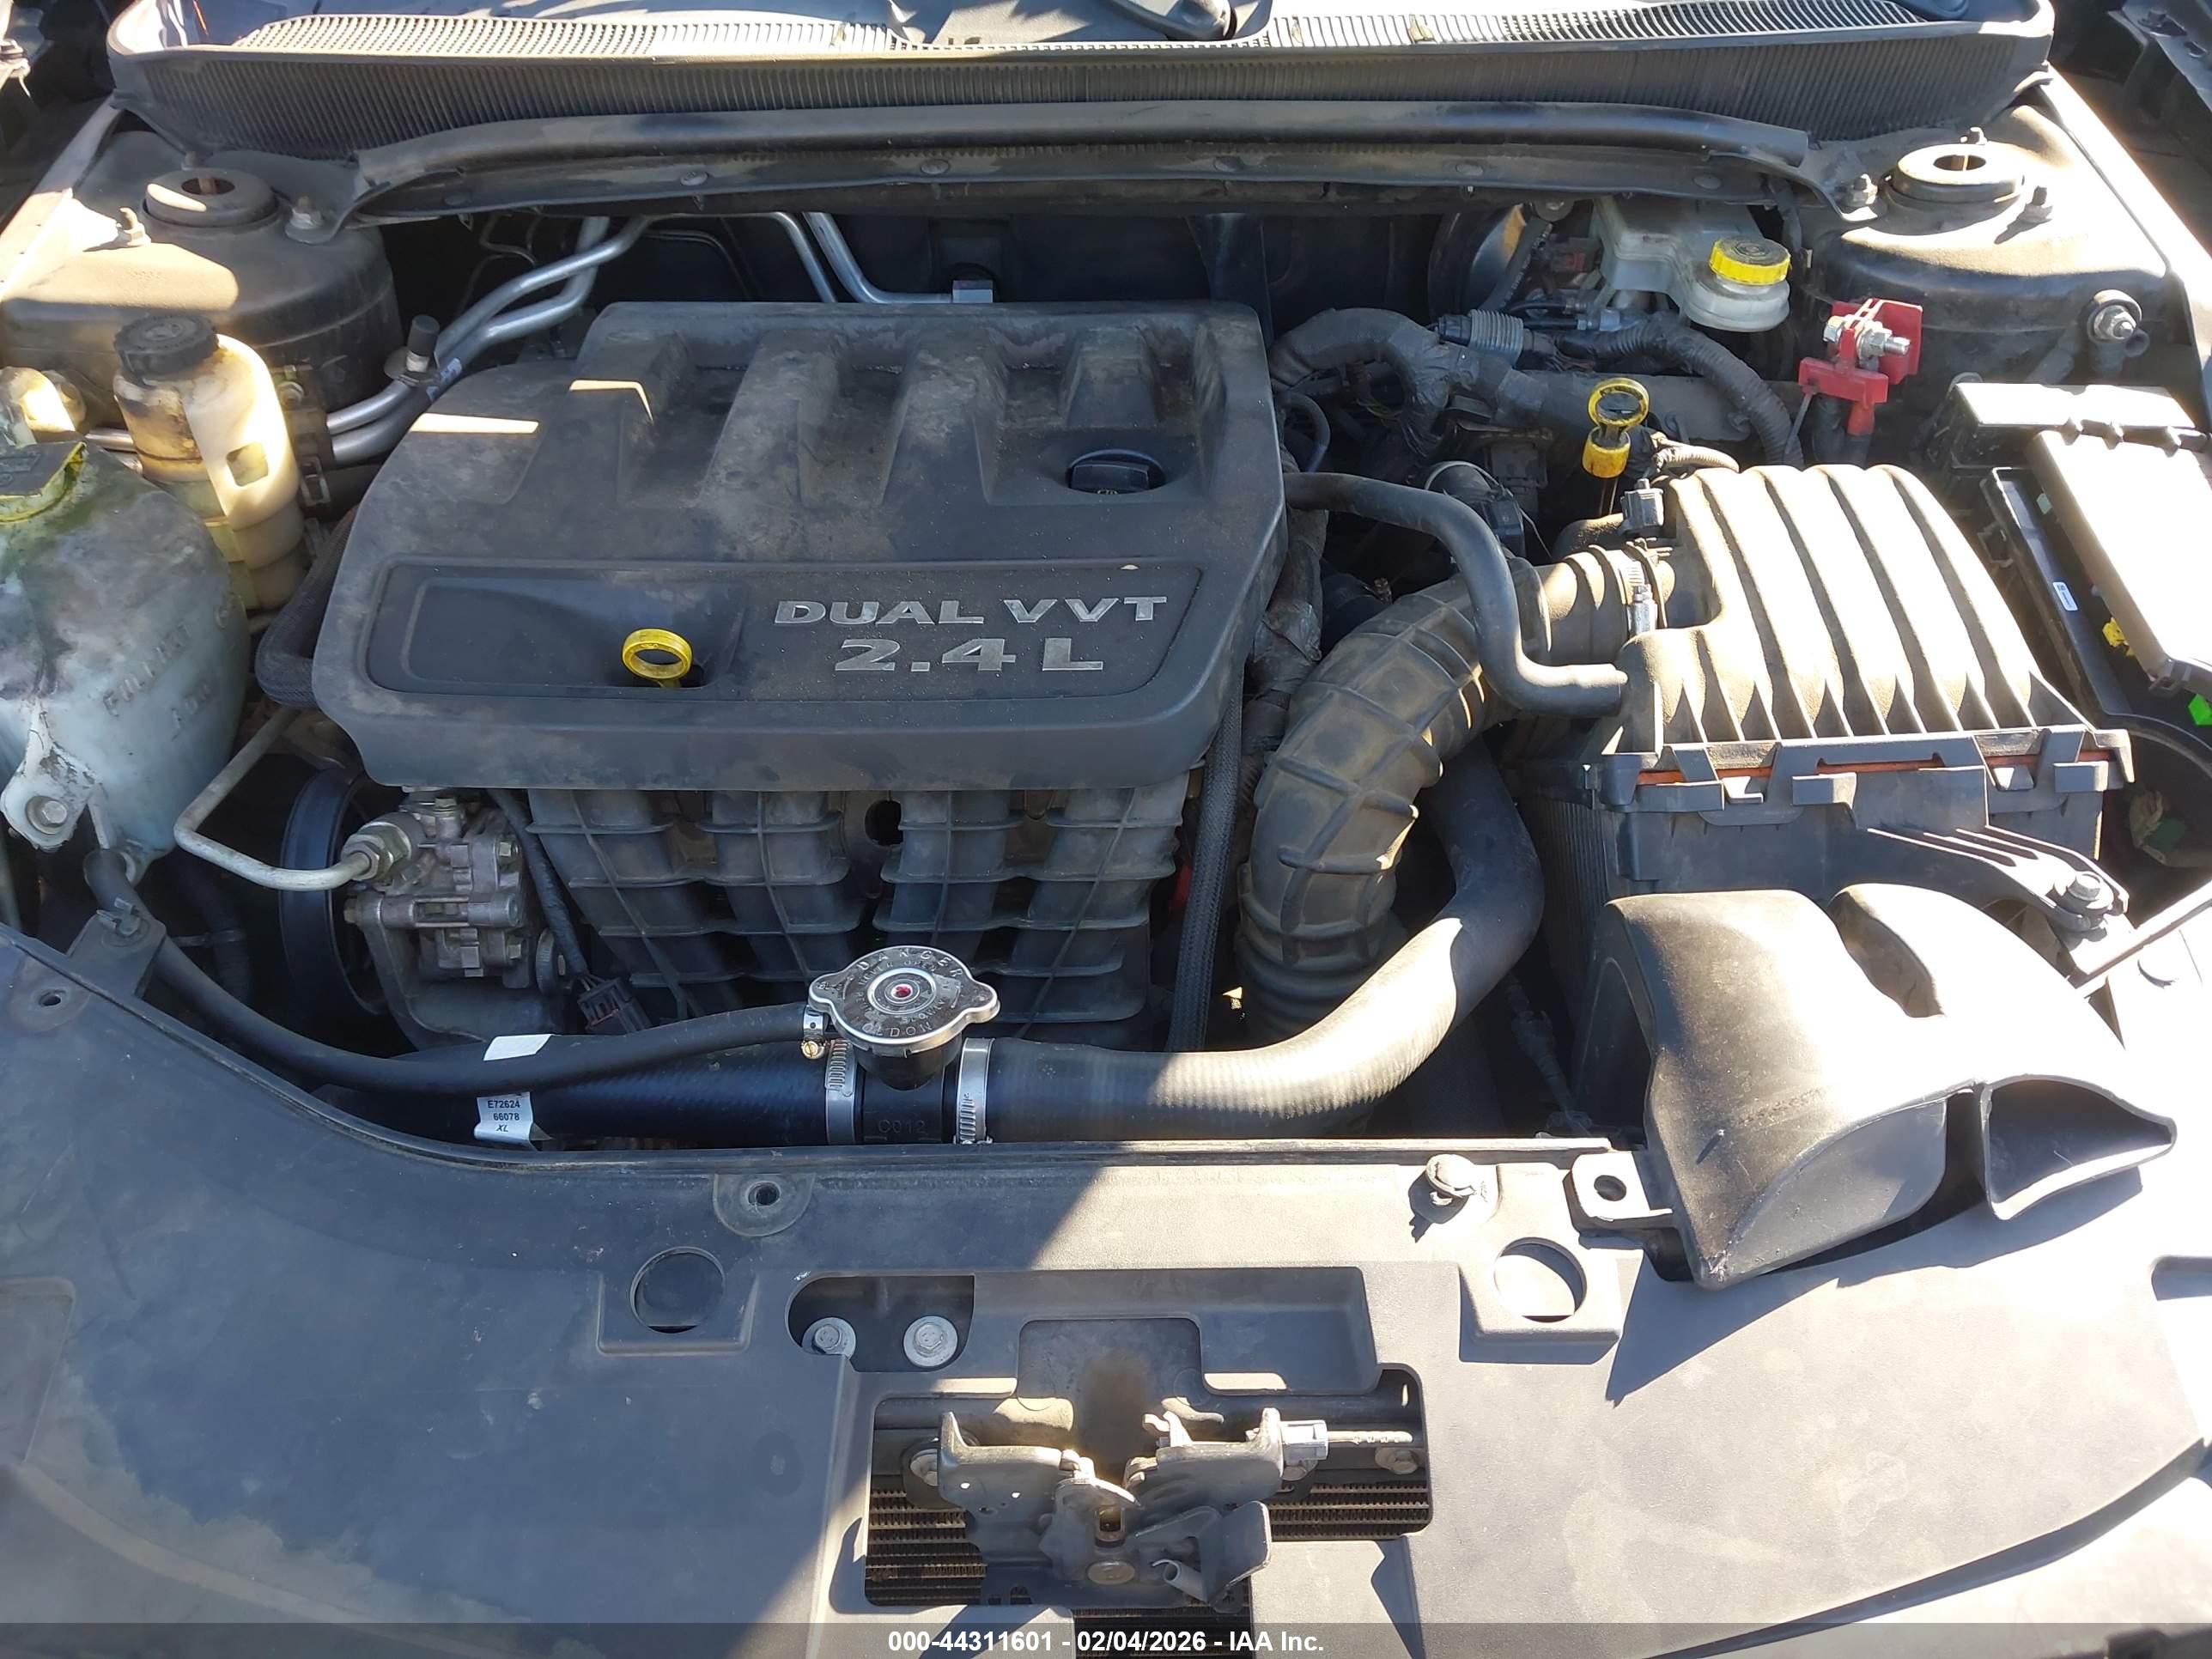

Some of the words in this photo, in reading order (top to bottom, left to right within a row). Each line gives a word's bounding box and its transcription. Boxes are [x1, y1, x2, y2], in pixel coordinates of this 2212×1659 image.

[774, 599, 984, 625] DUAL
[1003, 596, 1167, 623] VVT
[835, 637, 1017, 672] 2.4
[1042, 637, 1103, 672] L
[856, 947, 963, 977] DANGER
[487, 1100, 520, 1109] E72624
[493, 1112, 520, 1121] 66078
